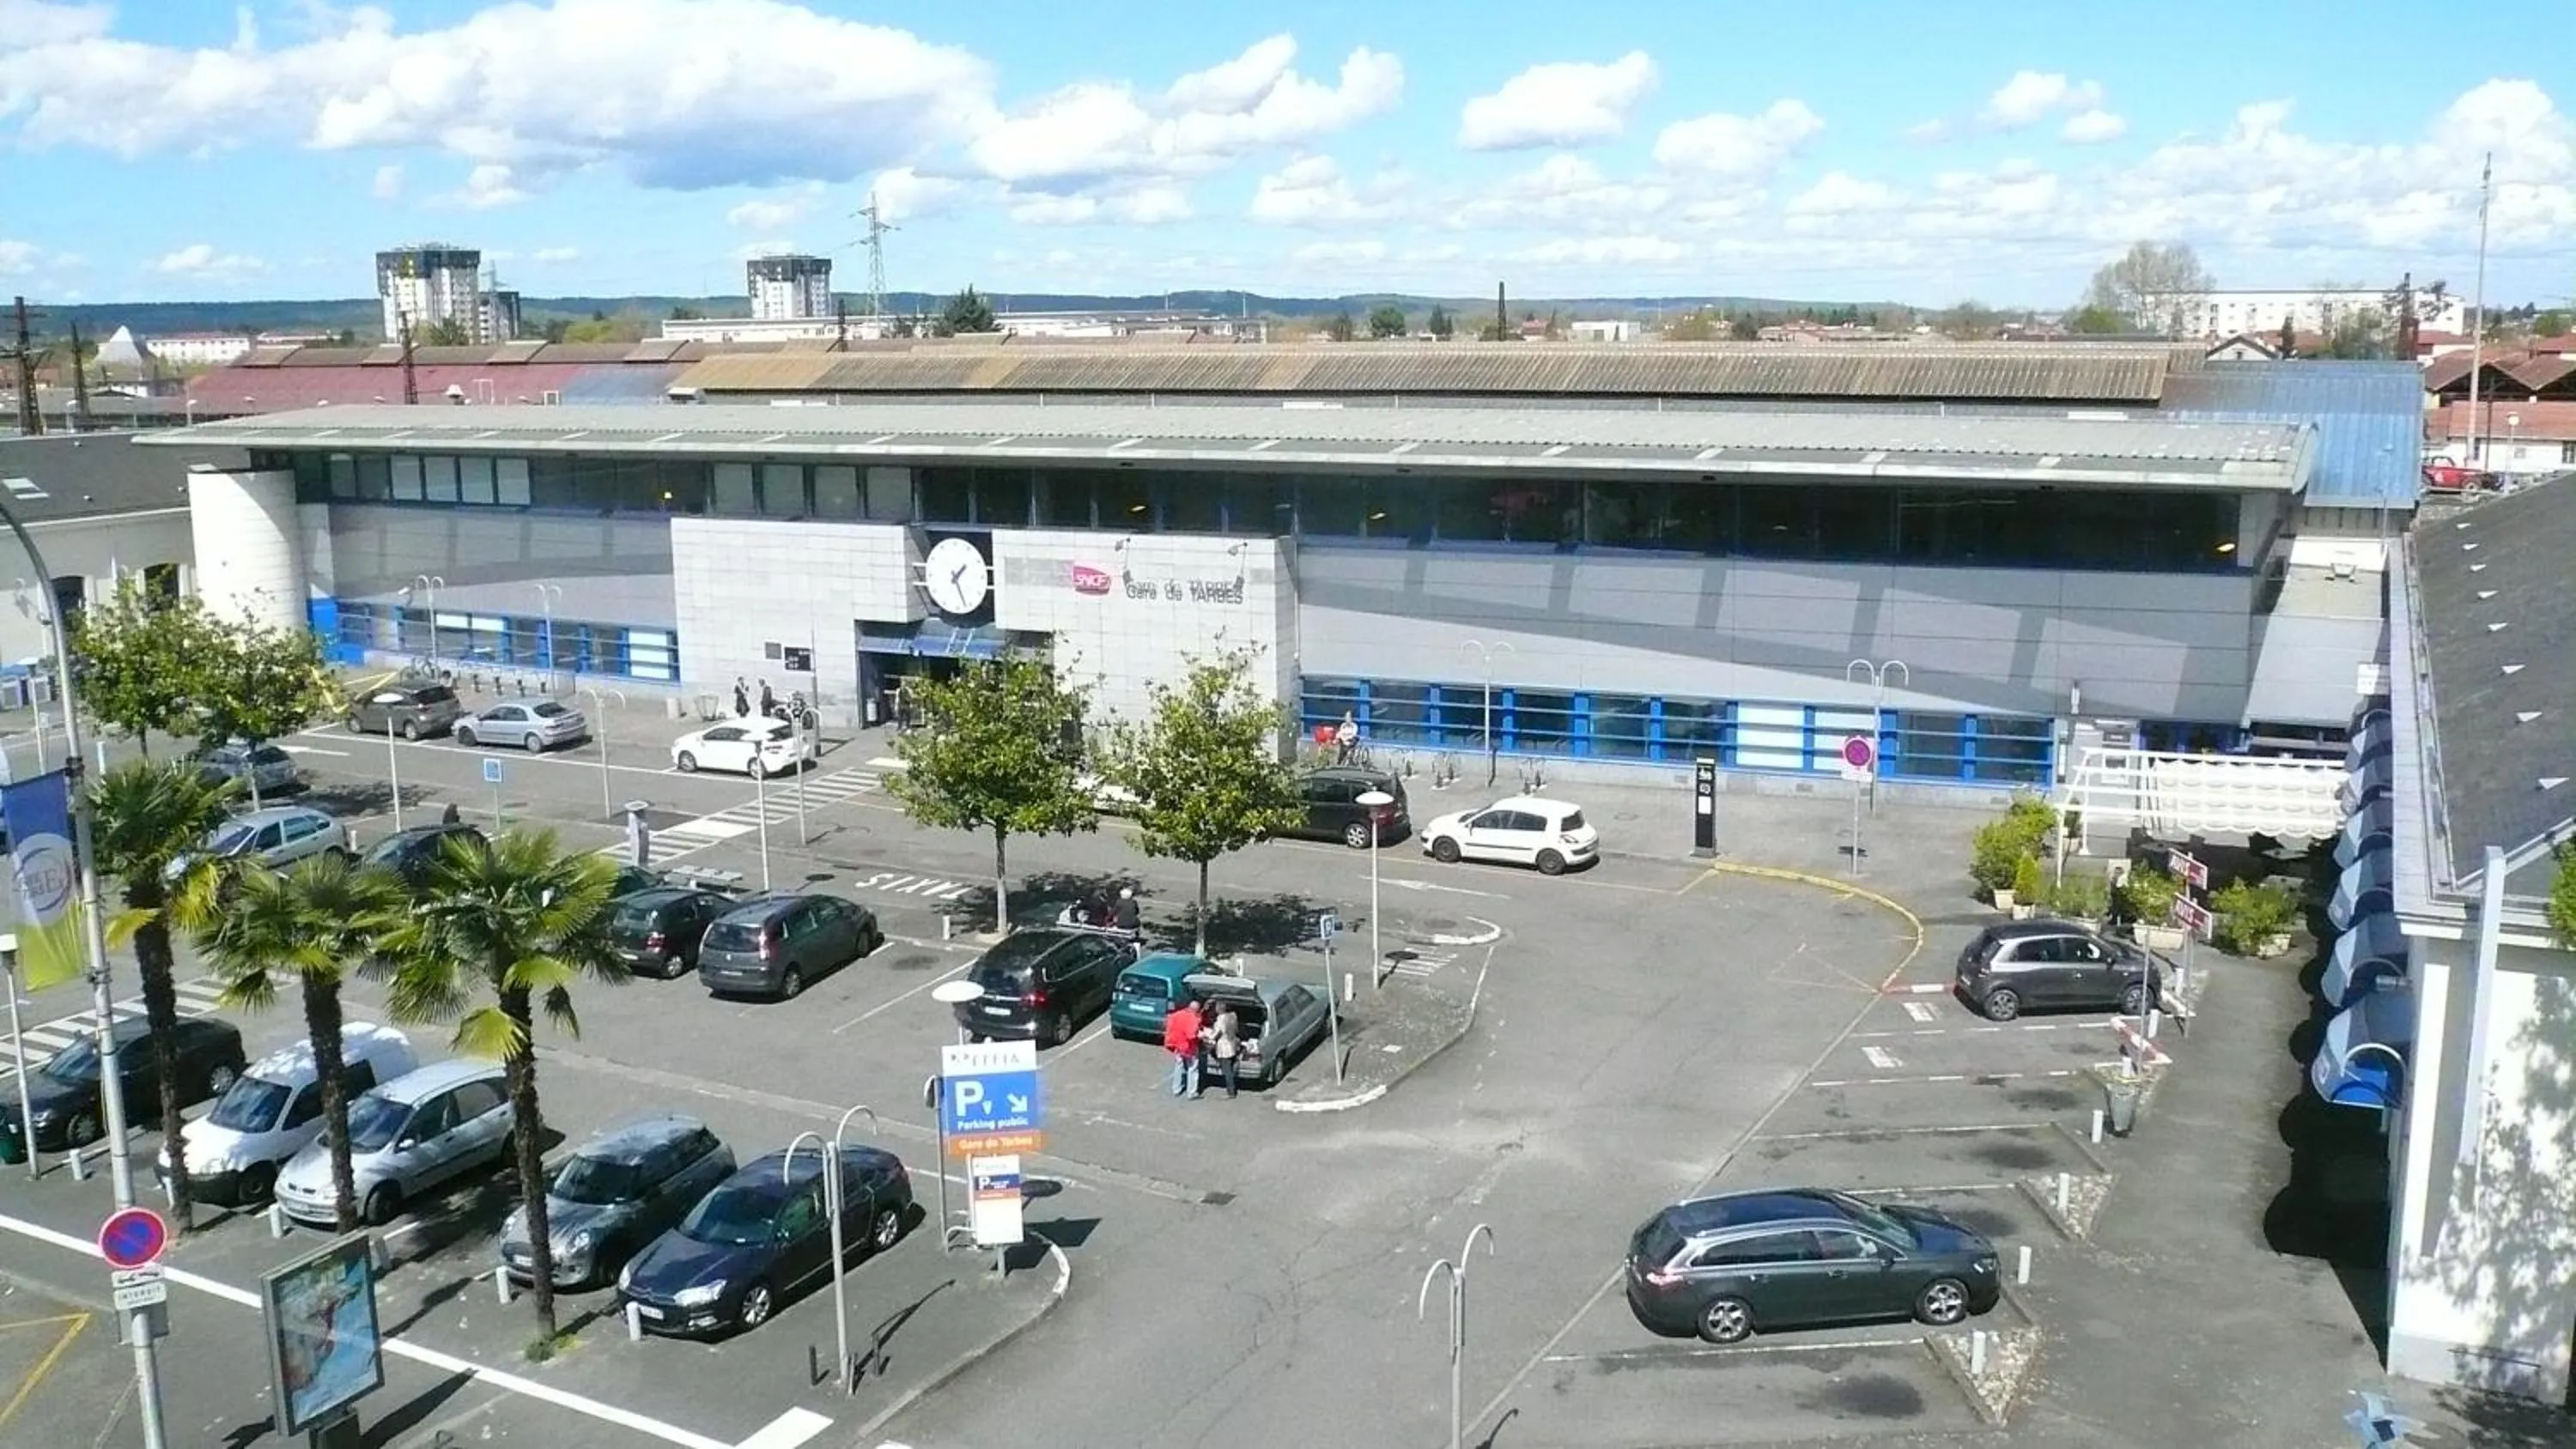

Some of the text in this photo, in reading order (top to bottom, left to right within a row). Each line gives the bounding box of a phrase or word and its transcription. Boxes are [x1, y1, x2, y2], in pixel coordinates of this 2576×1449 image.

[1075, 573, 1109, 587] SNCF
[1125, 581, 1157, 600] Gare
[1189, 579, 1244, 604] TARBES
[854, 873, 973, 900] TAXIS
[955, 1081, 983, 1117] P
[957, 1117, 1030, 1131] Parking public
[958, 1135, 1033, 1149] Gare de Tarbes
[979, 1177, 991, 1190] P
